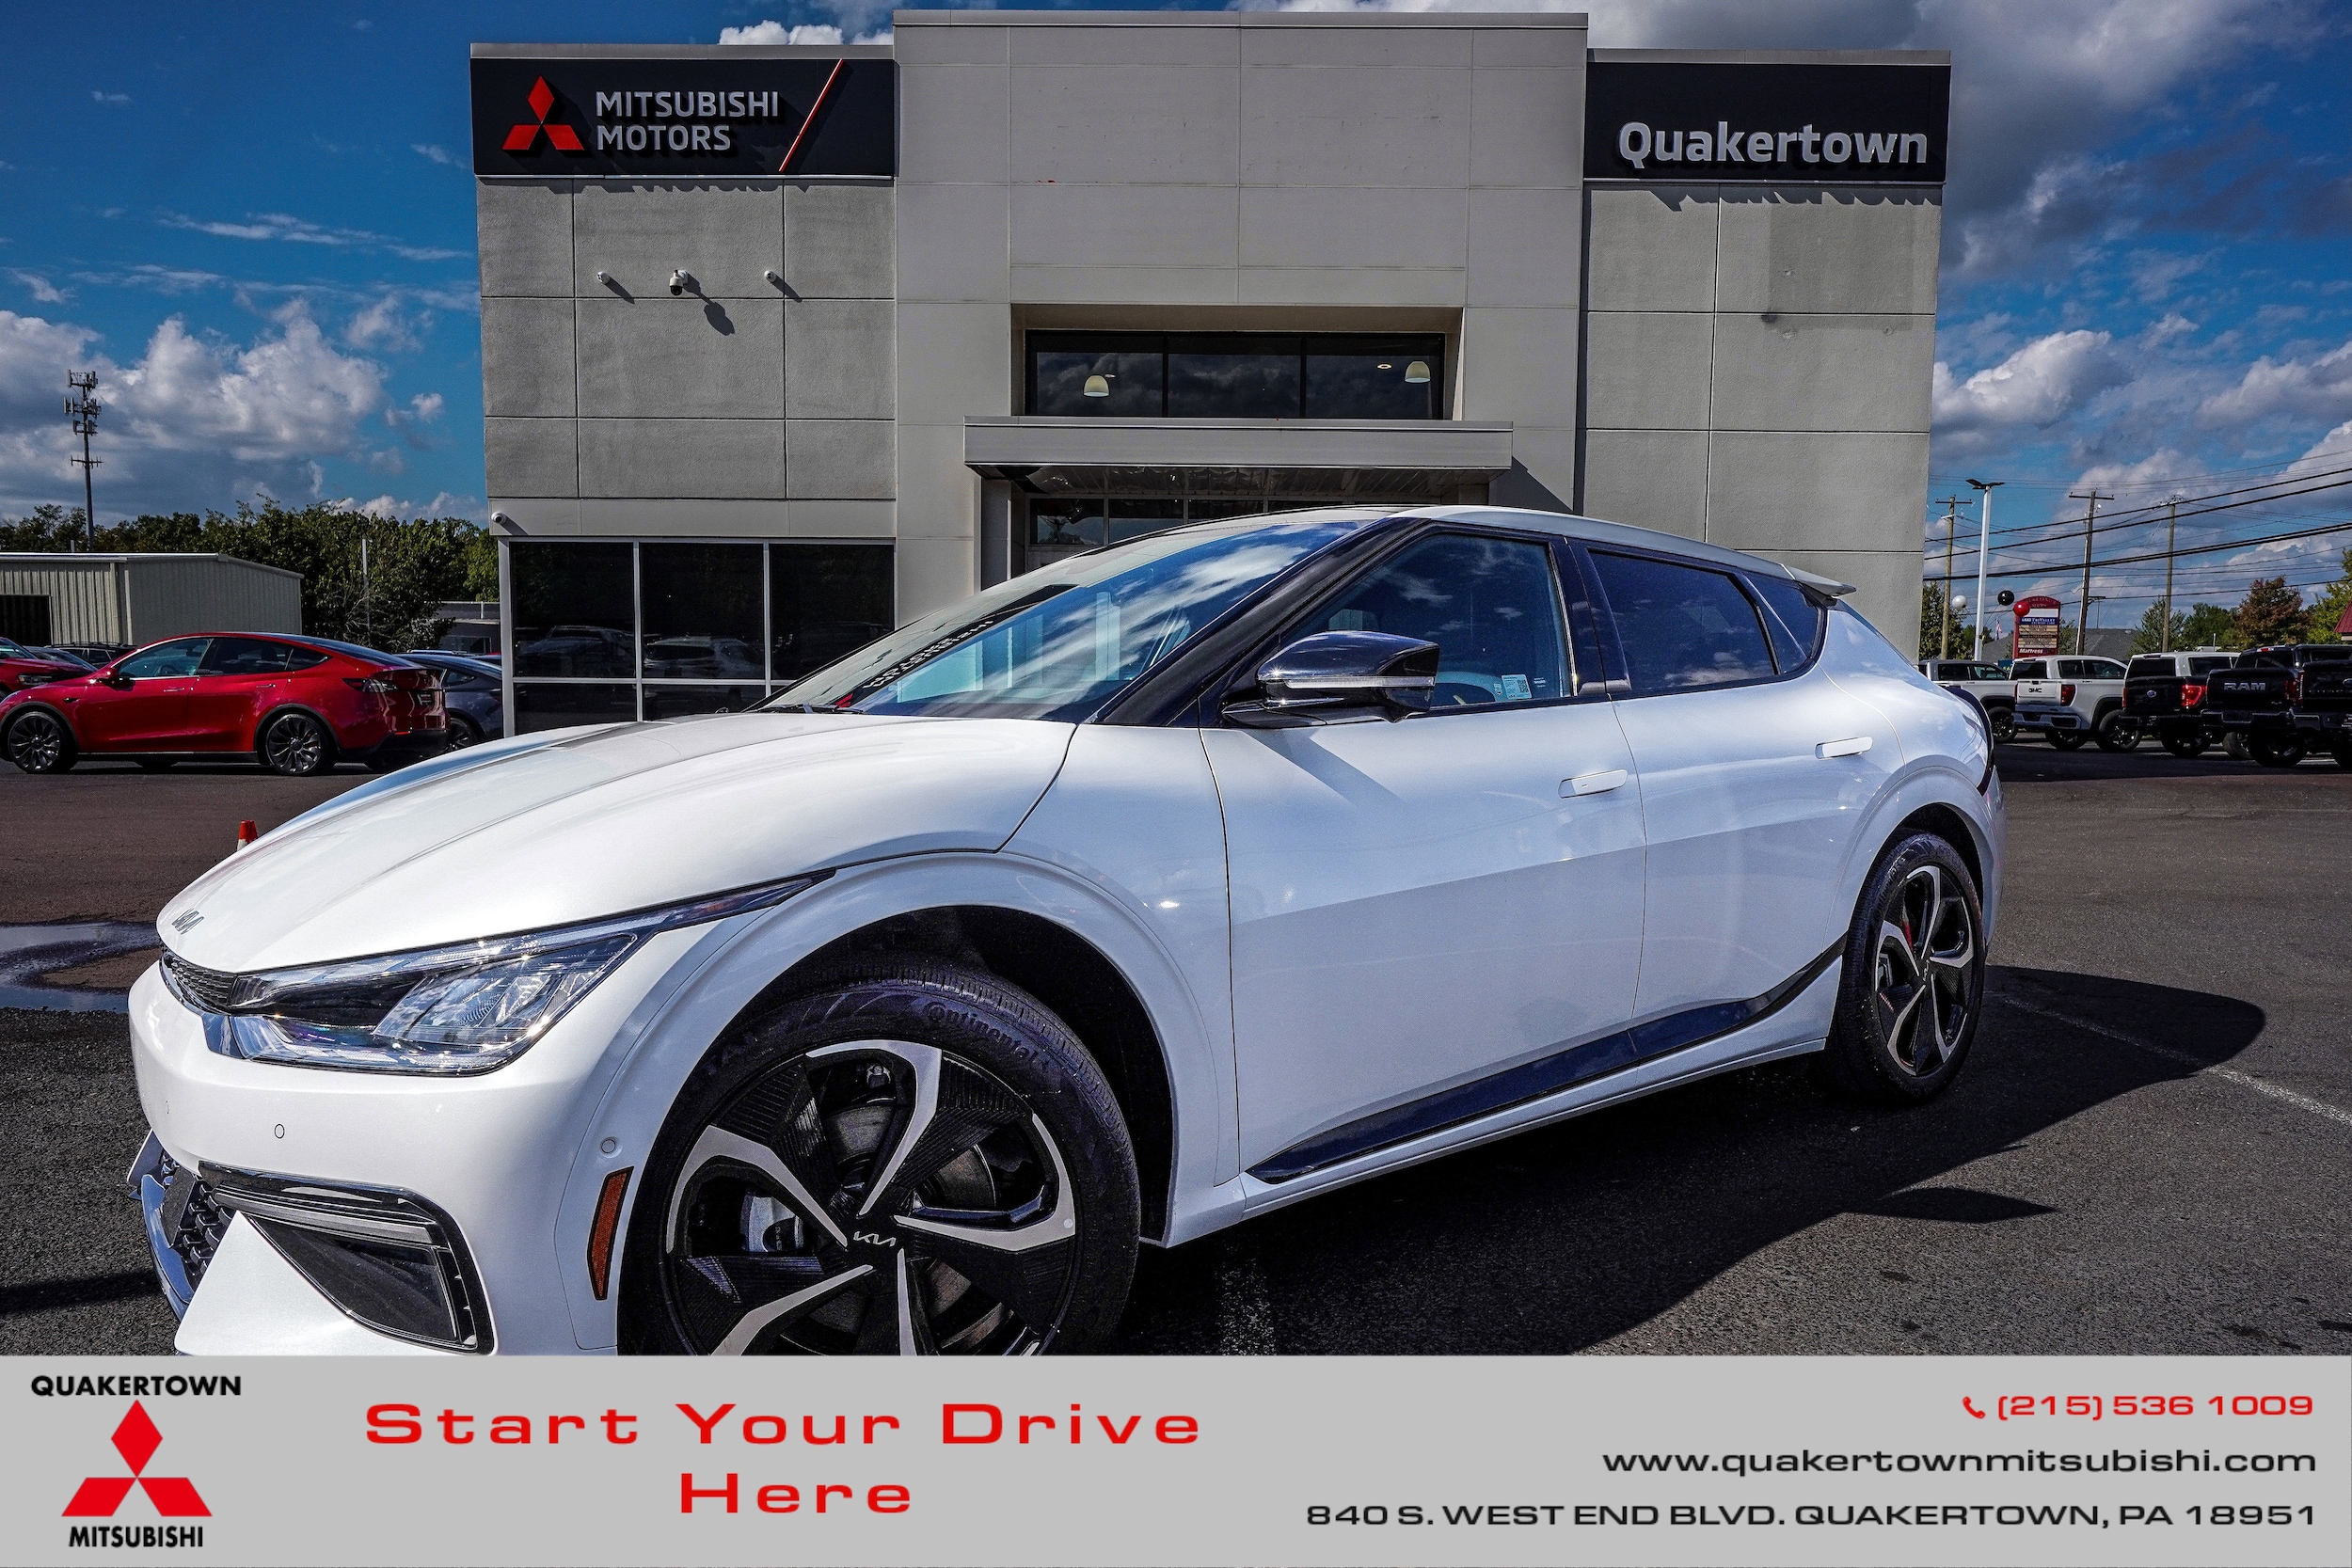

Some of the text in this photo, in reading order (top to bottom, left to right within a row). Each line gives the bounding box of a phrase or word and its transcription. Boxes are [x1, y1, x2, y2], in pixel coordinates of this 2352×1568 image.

[596, 91, 779, 118] MITSUBISHI
[596, 125, 731, 150] MOTORS
[1618, 120, 1928, 169] Quakertown
[2223, 682, 2266, 691] RAM
